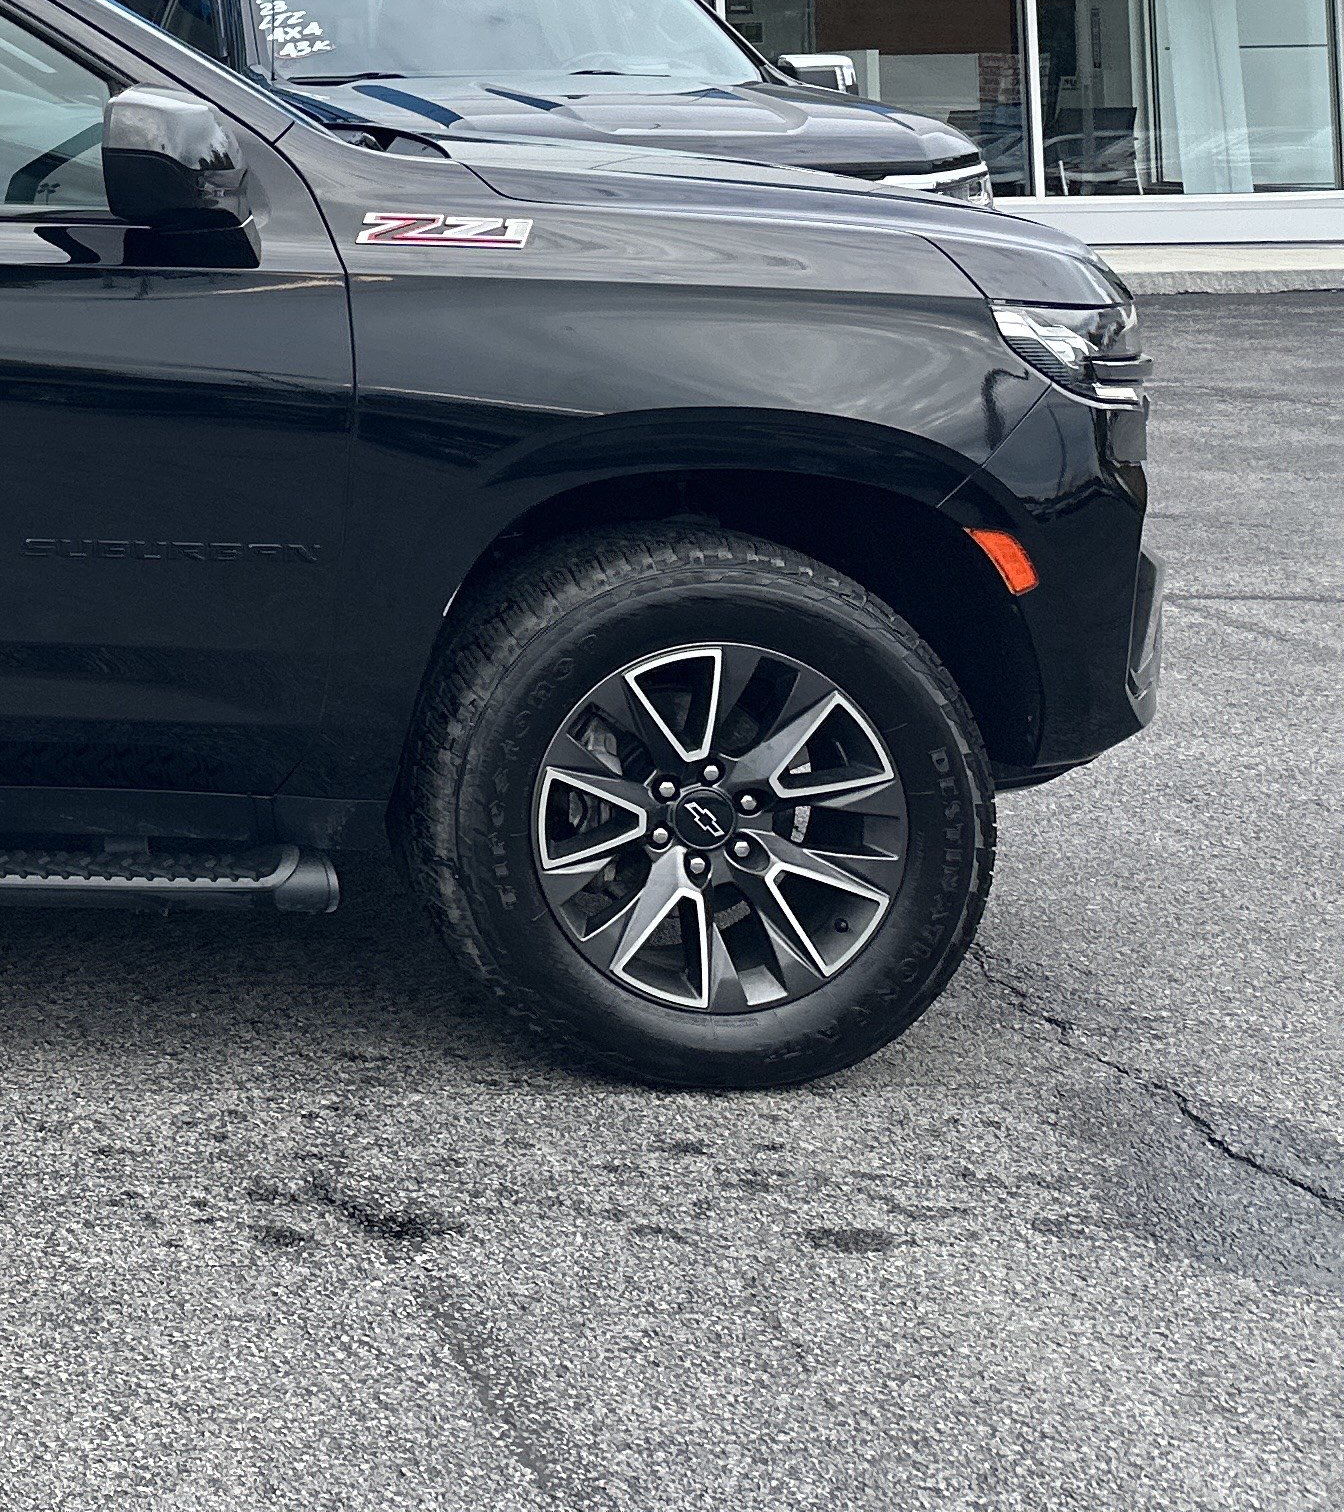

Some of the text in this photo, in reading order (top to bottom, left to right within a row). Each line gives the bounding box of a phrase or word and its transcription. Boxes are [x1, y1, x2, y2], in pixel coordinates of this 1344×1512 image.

[258, 10, 307, 30] LTZ
[354, 212, 534, 249] Z71
[21, 537, 322, 562] SUBURBAN
